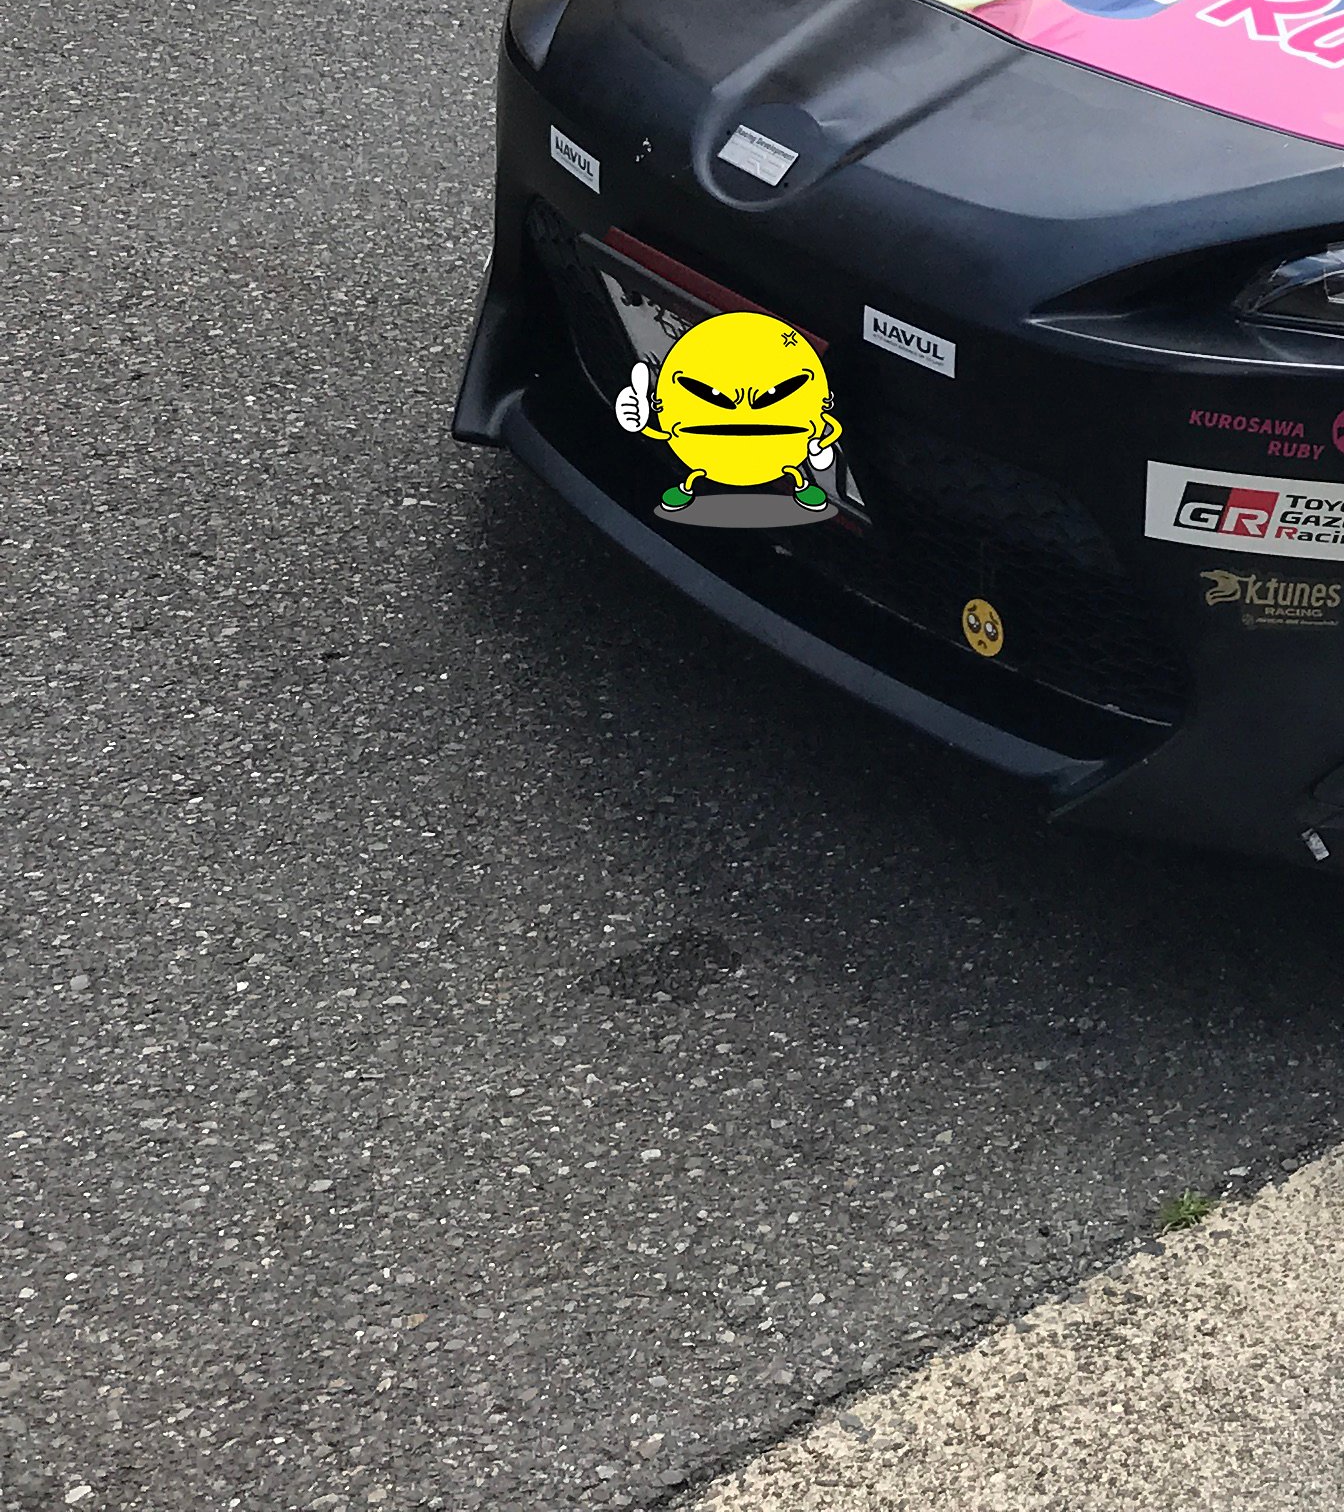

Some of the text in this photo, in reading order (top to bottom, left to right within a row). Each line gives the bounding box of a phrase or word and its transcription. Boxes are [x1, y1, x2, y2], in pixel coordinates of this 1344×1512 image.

[555, 136, 594, 177] NAVUL
[873, 317, 945, 361] NAVUL
[1189, 410, 1305, 438] KUROSAWA
[1268, 441, 1326, 460] RUBY
[1176, 499, 1271, 537] GR
[1265, 607, 1323, 617] RACING
